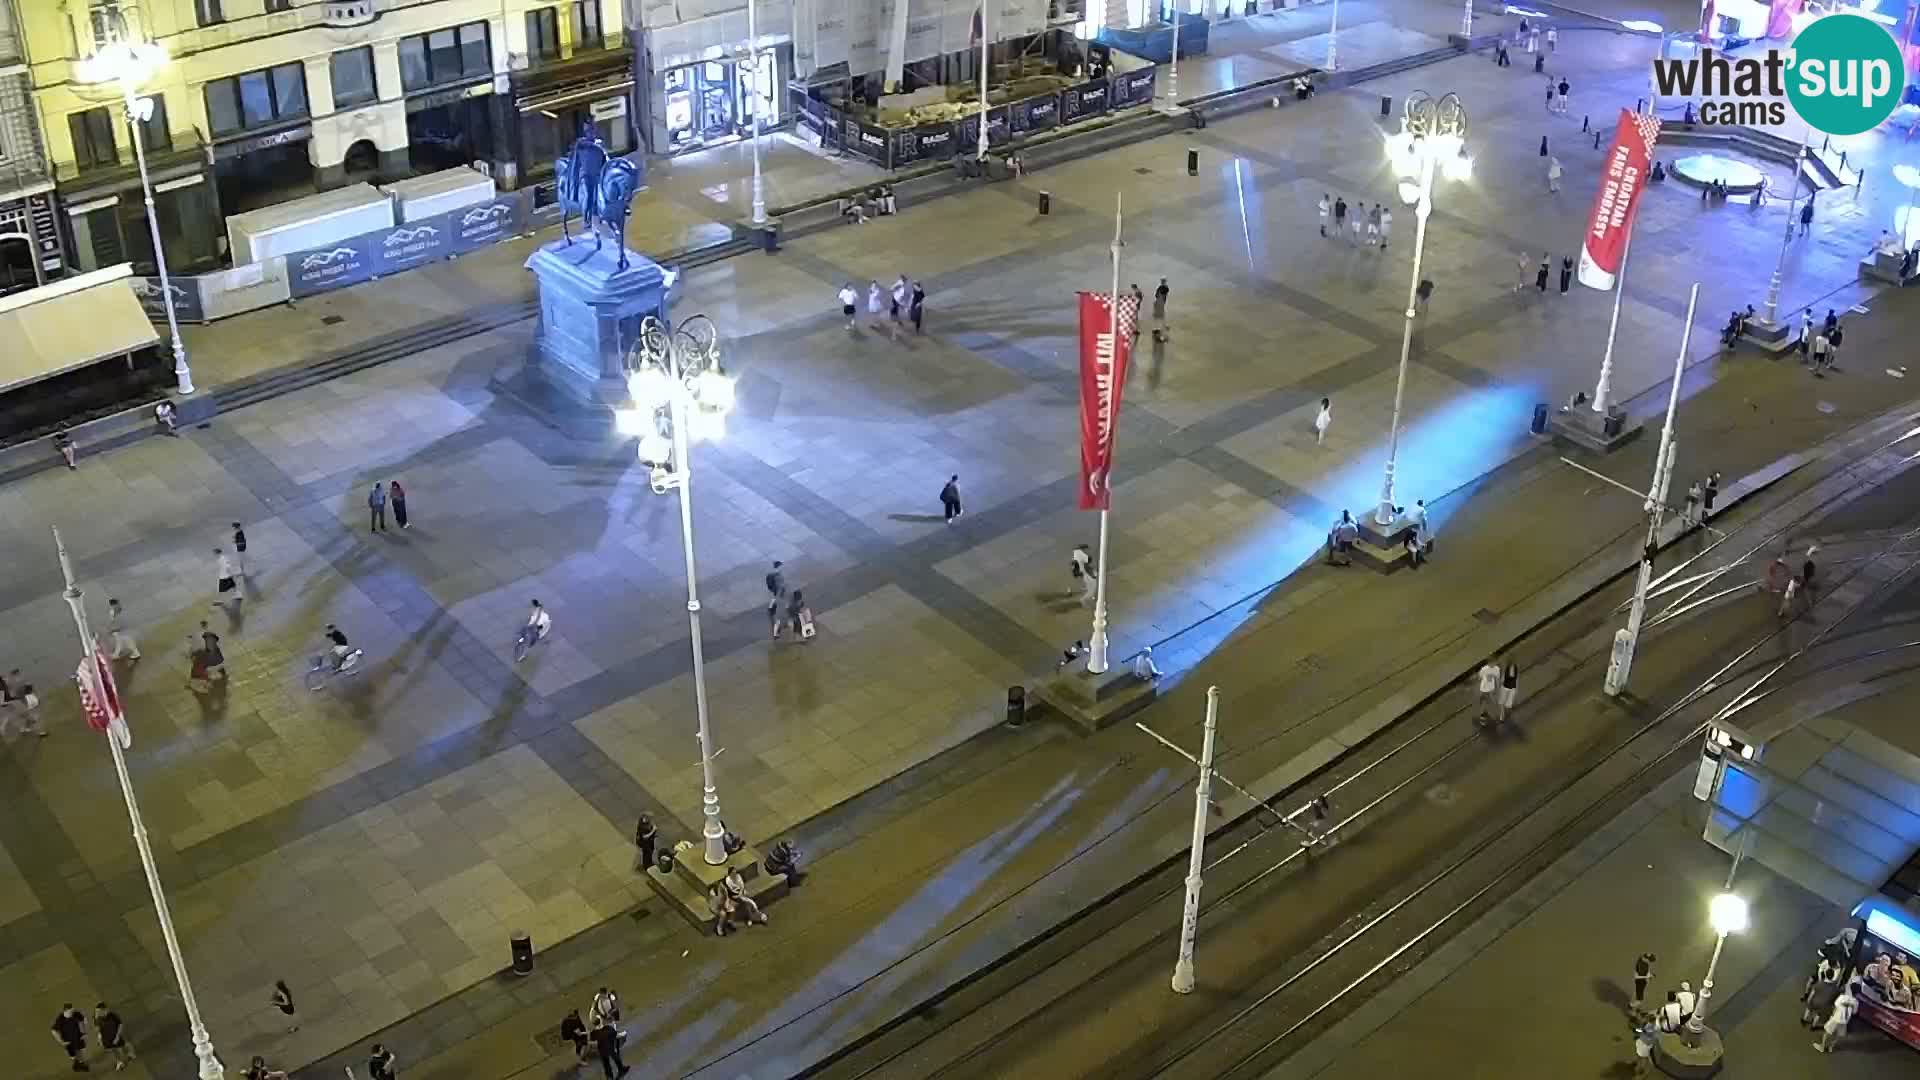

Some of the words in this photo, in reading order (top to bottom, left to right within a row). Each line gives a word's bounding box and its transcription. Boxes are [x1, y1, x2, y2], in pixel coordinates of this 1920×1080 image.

[1609, 145, 1630, 178] FANS
[1593, 180, 1619, 240] EMBASSY
[1610, 166, 1638, 228] CROATIAN
